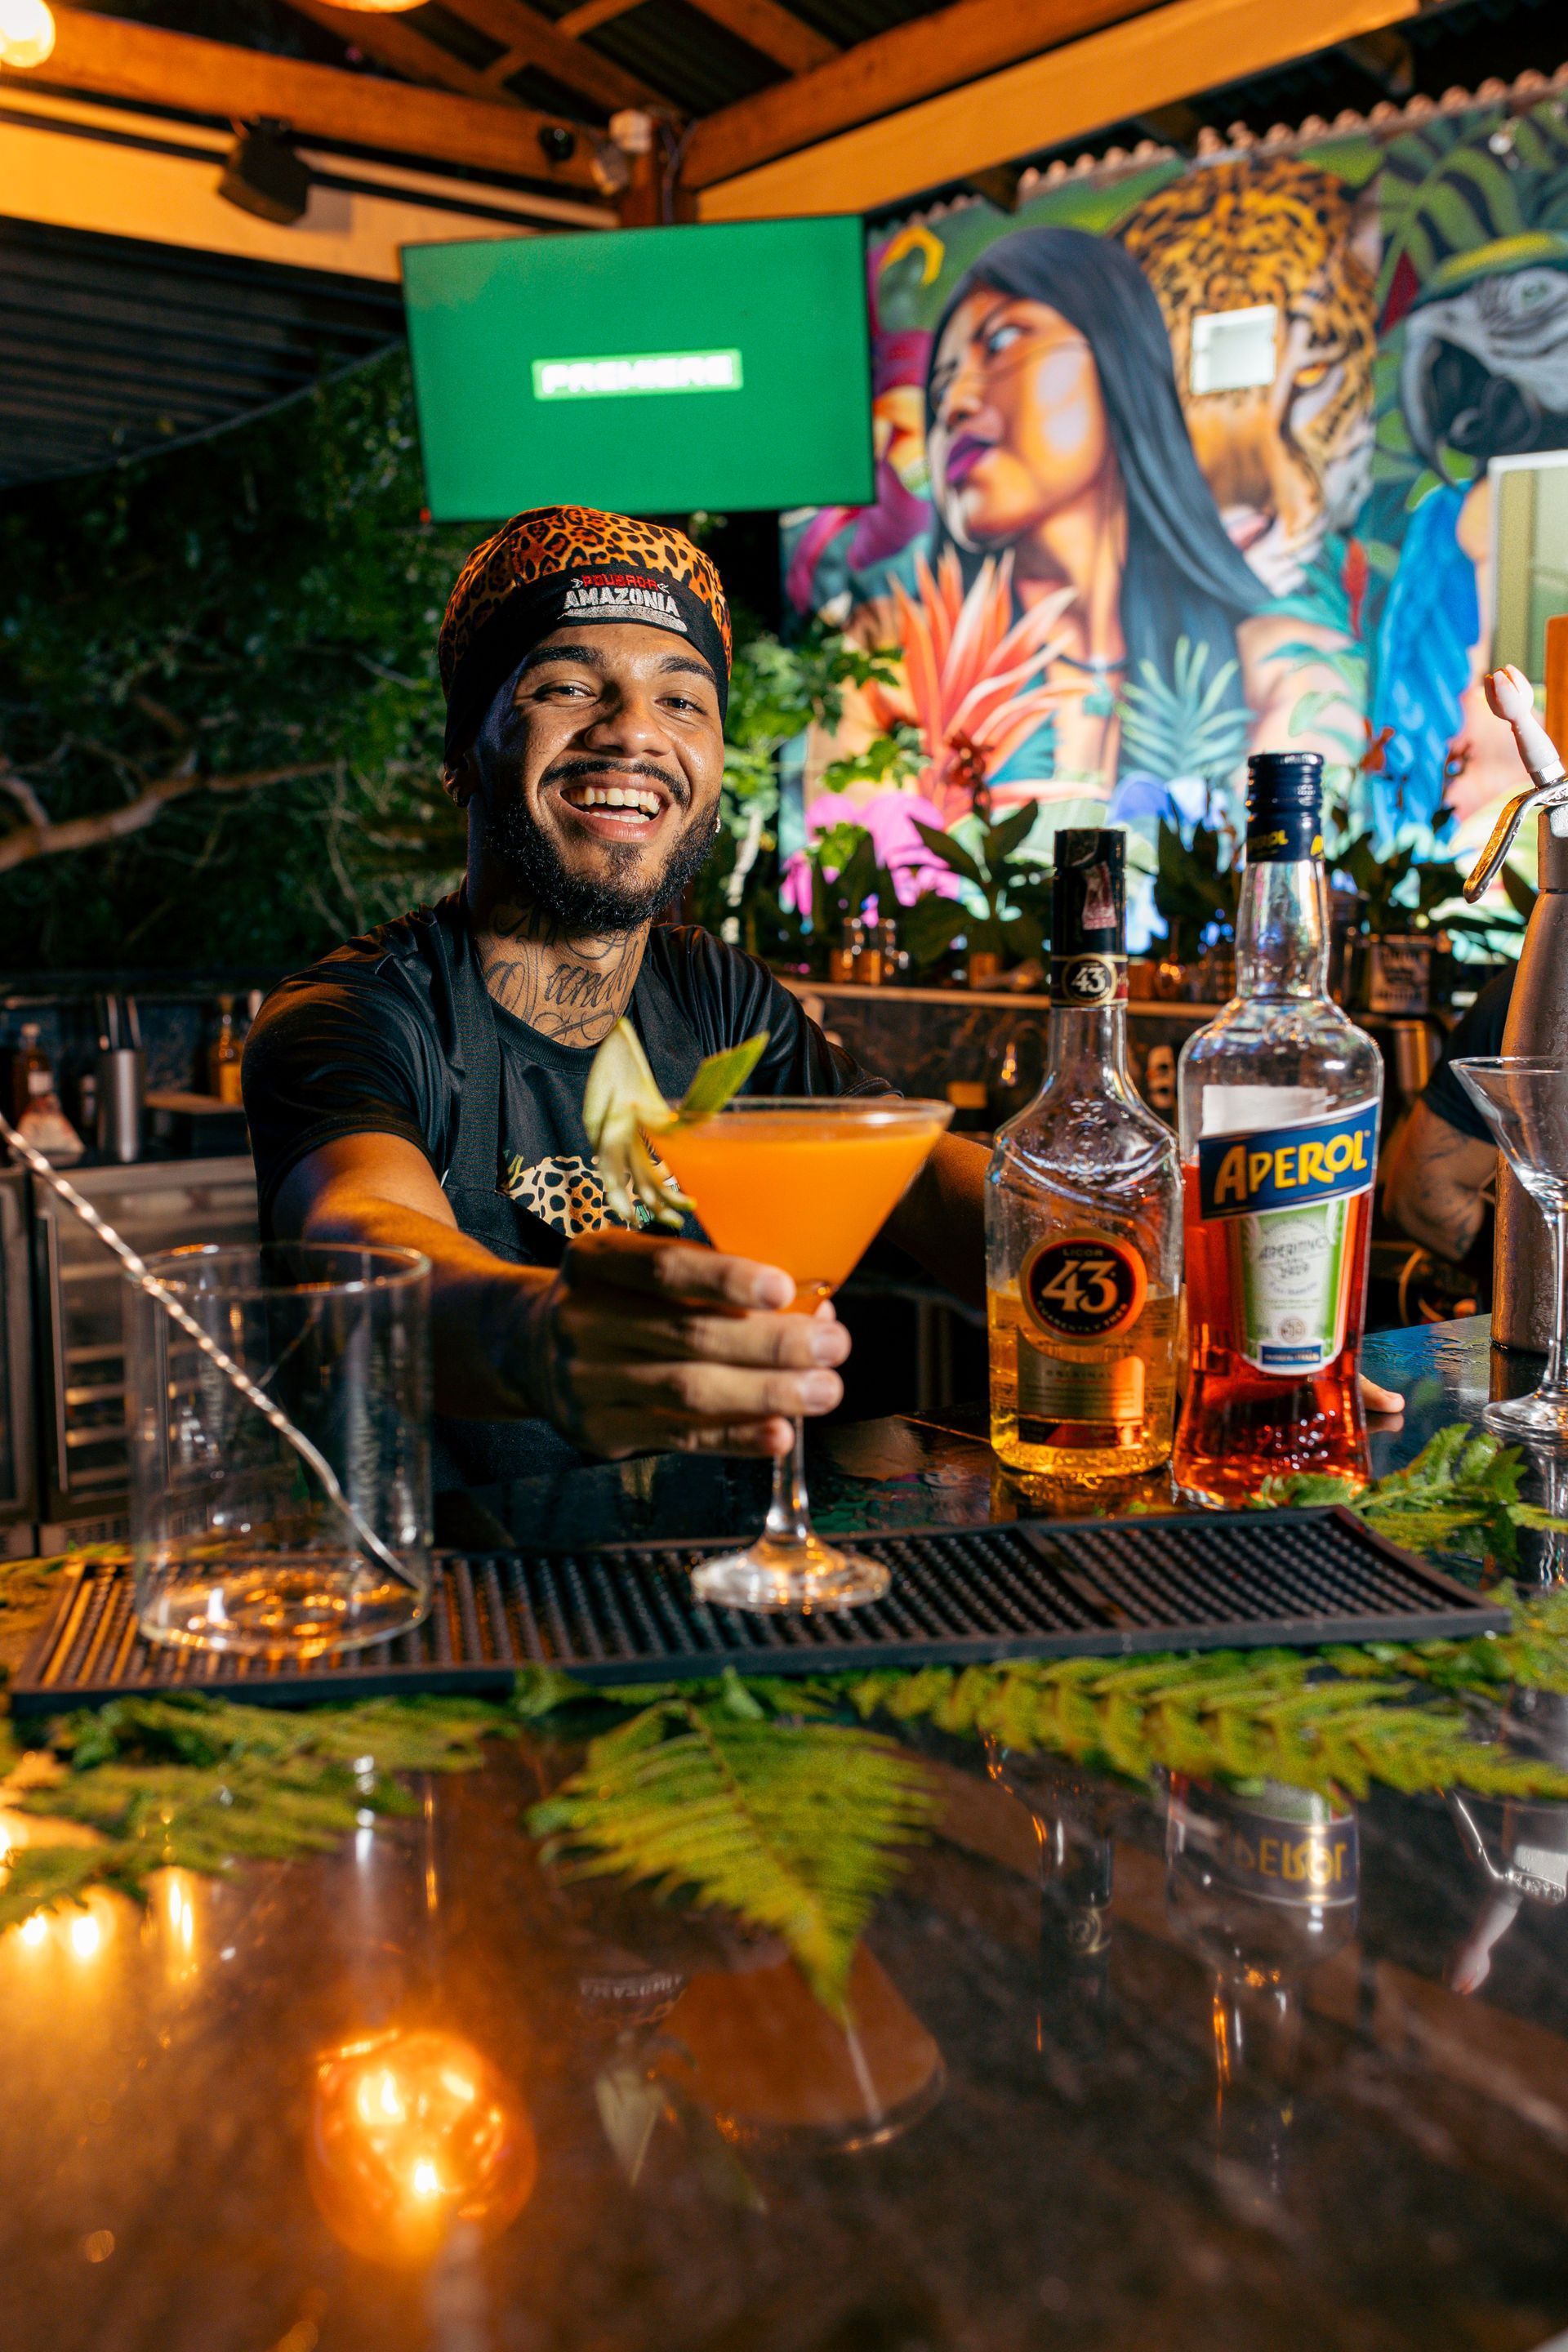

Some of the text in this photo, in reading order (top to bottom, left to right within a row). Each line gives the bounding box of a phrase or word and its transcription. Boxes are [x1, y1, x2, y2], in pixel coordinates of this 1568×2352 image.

[581, 573, 659, 591] POUSADA
[563, 586, 681, 618] AMAZONIA
[1071, 966, 1106, 993] 43
[1214, 1129, 1368, 1205] APEROL
[1062, 1248, 1104, 1257] LICOR
[1041, 1260, 1119, 1315] 43
